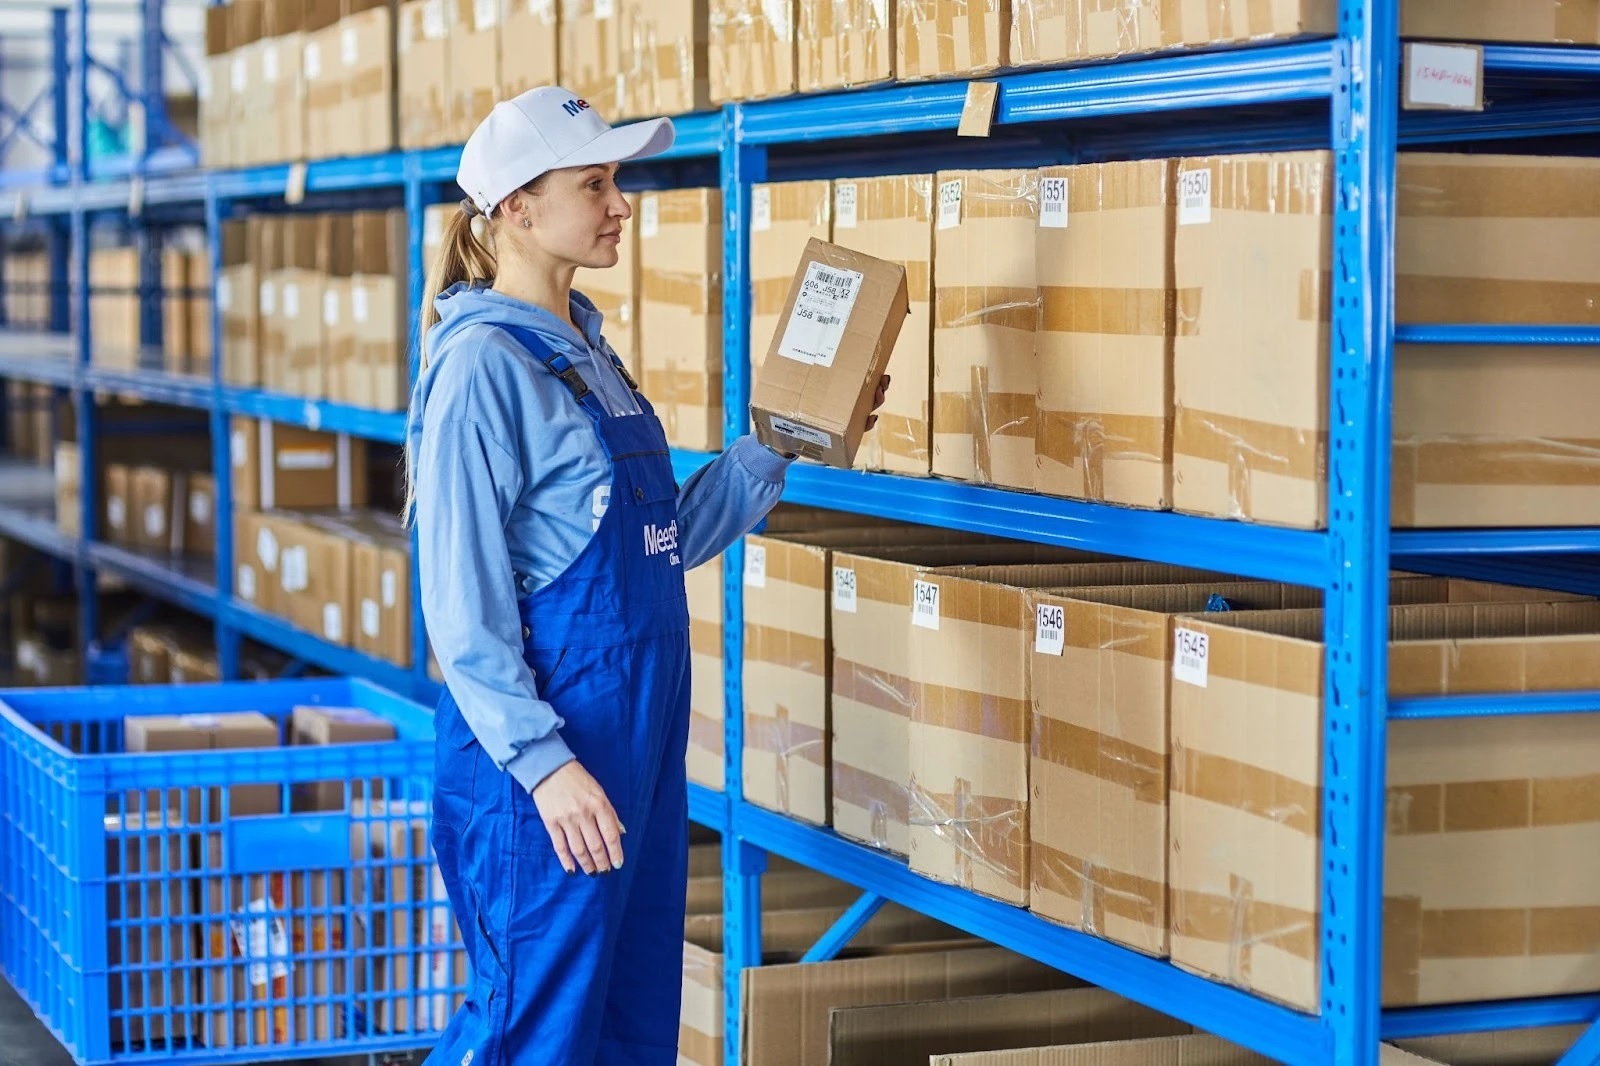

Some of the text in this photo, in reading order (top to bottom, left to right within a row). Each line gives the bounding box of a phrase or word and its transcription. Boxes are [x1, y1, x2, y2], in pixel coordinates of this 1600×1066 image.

[940, 182, 960, 205] 1552
[1041, 180, 1065, 202] 1551
[1182, 171, 1209, 197] 1550
[804, 279, 819, 290] 606
[822, 286, 837, 295] J58
[797, 308, 814, 320] J58
[835, 569, 856, 590] 1548
[914, 582, 938, 606] 1547
[1038, 606, 1063, 630] 1546
[1178, 630, 1207, 658] 1545
